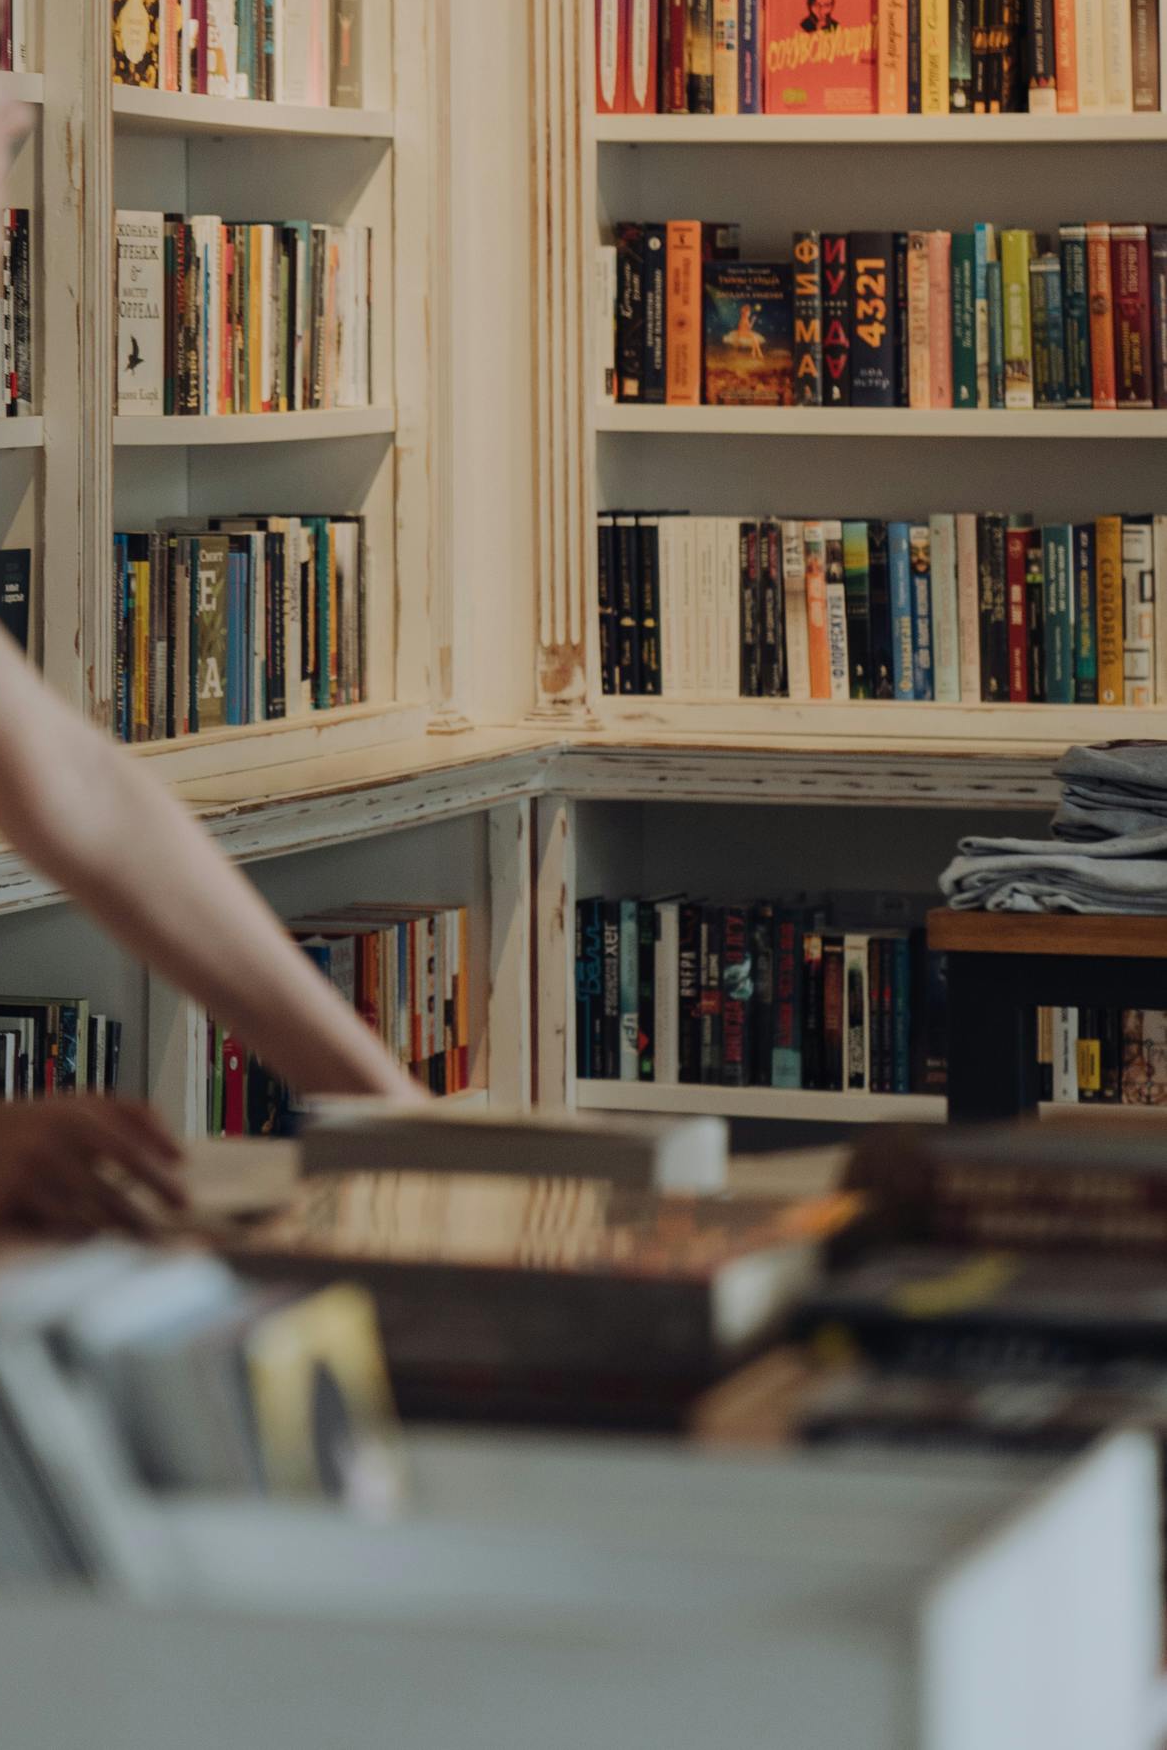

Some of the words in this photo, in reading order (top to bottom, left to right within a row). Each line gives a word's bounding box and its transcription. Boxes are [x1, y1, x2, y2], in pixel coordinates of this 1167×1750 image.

[118, 224, 159, 238] ЖОНАТАН
[118, 244, 159, 260] ТРЕНДЖ
[119, 301, 160, 319] ОРРЕЛЛ
[855, 257, 887, 348] 4321
[1098, 558, 1118, 668] СОЛОВЕЙ
